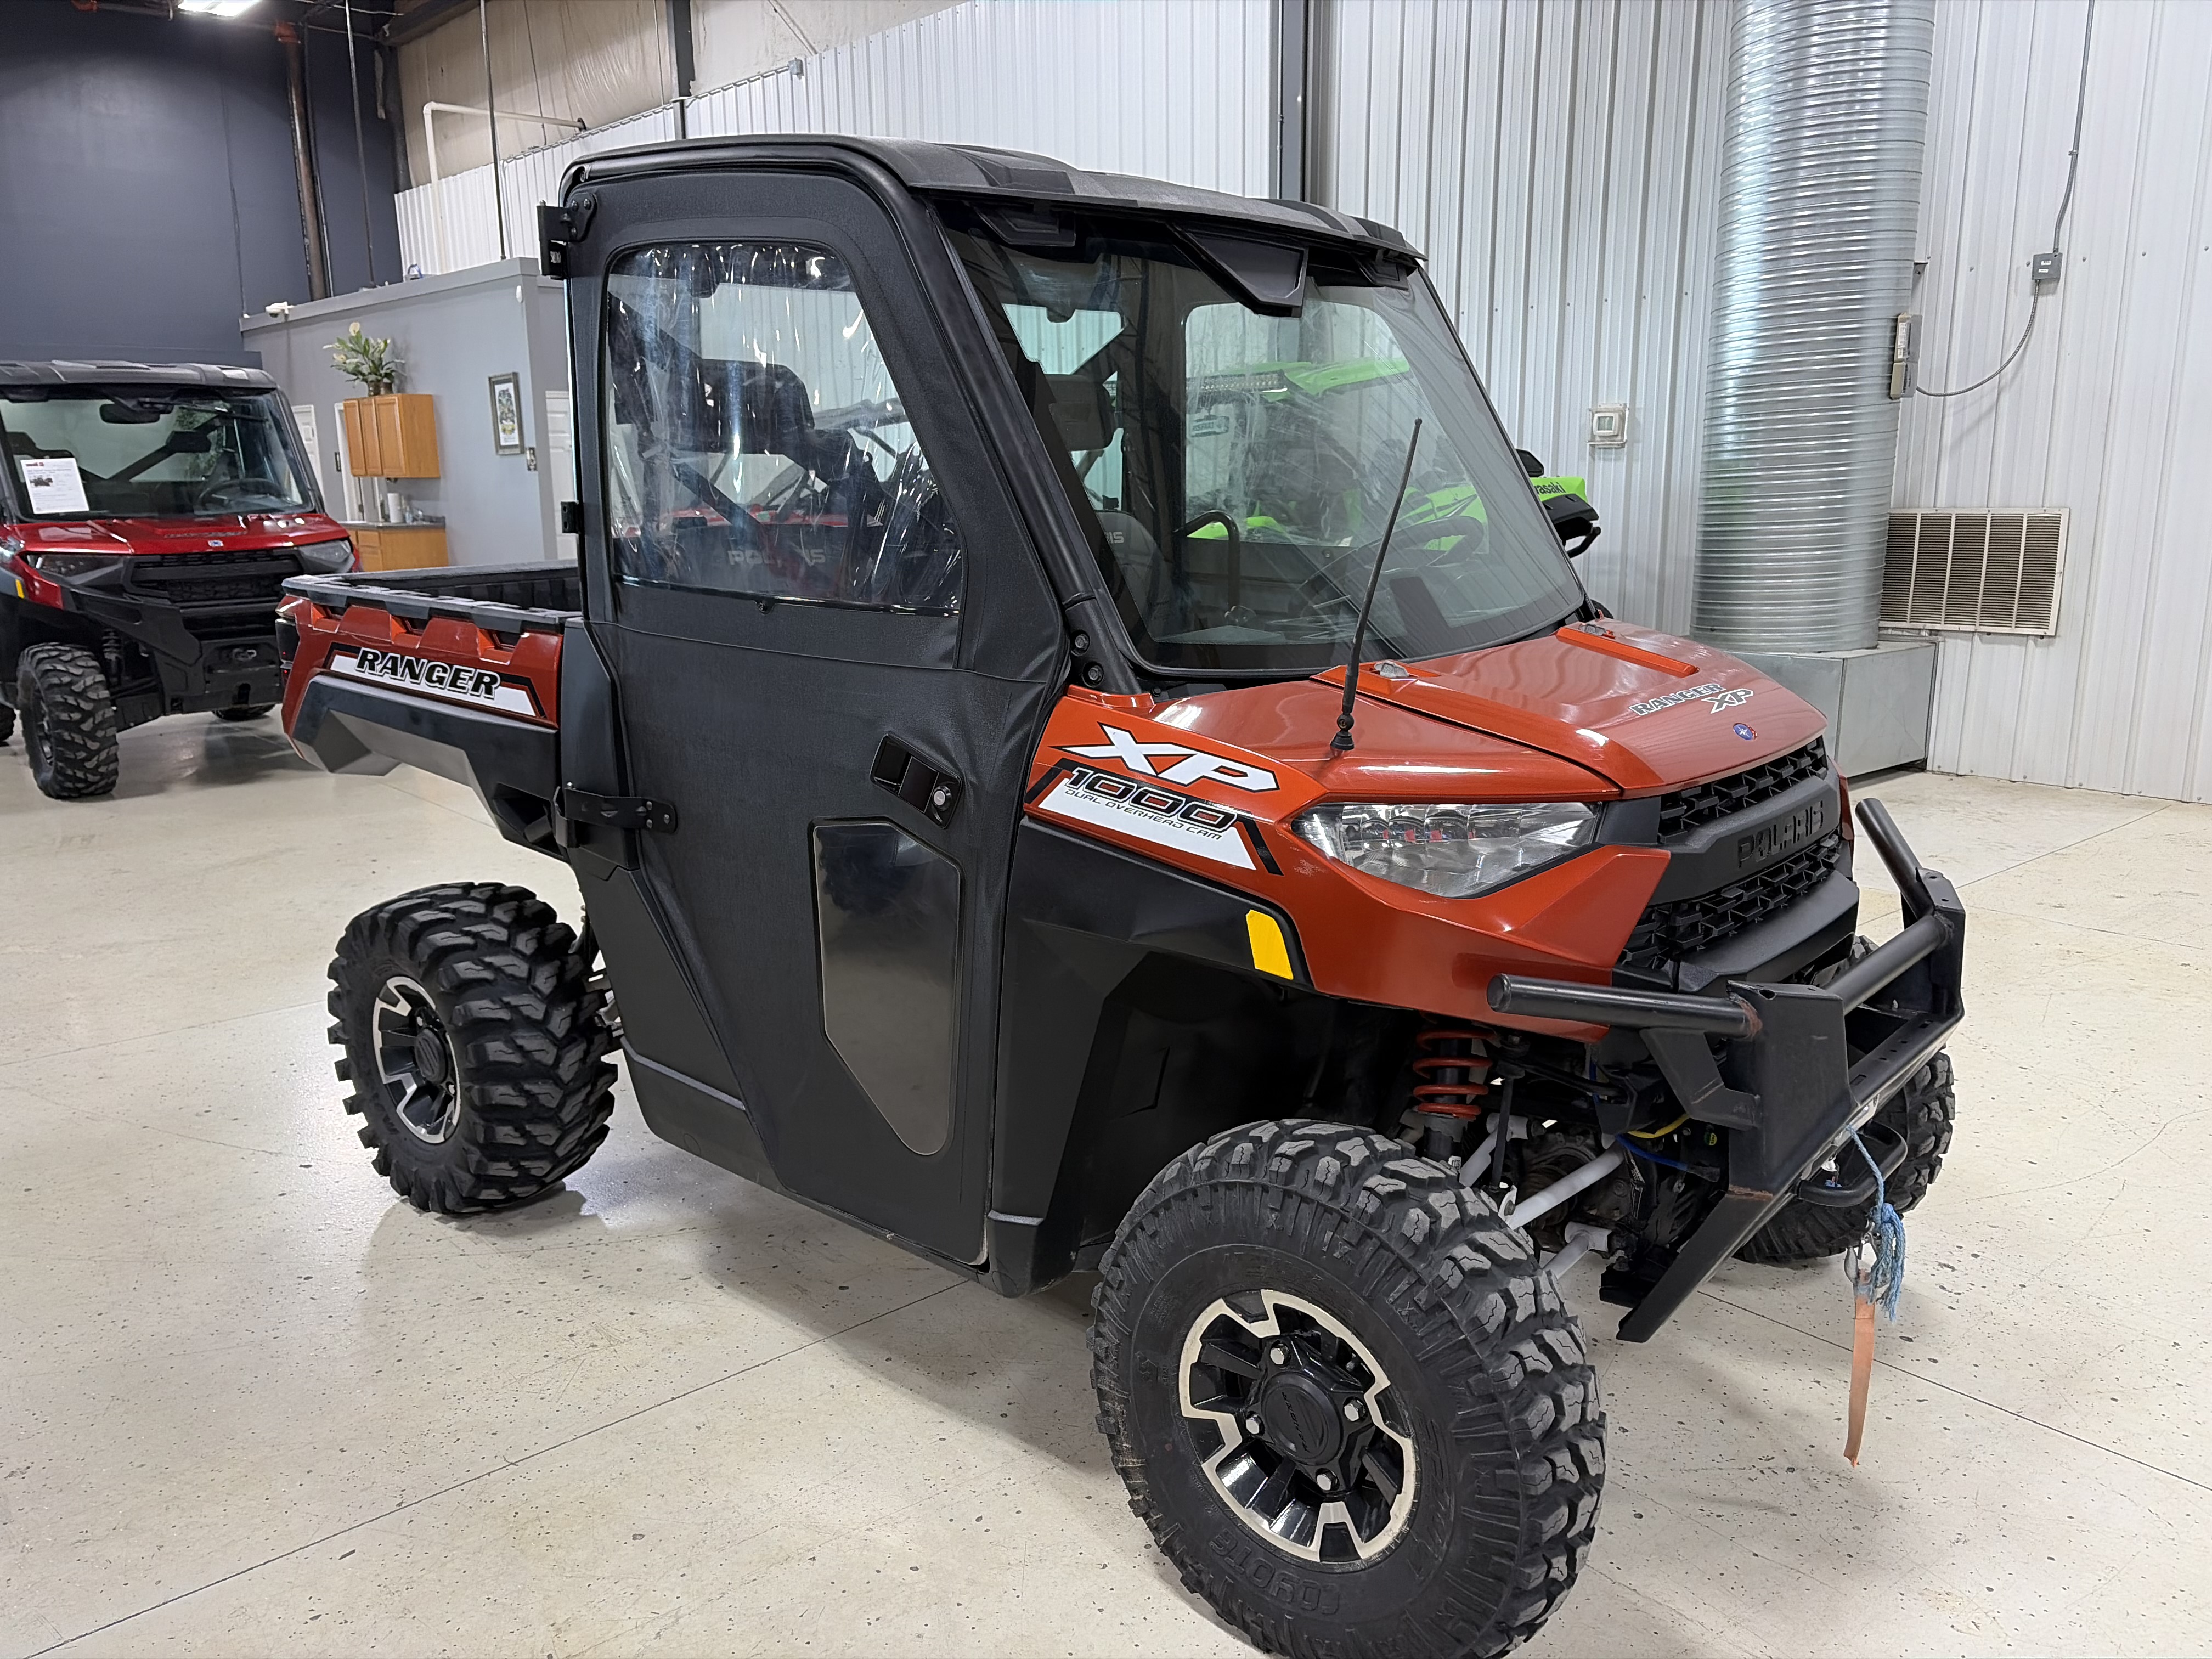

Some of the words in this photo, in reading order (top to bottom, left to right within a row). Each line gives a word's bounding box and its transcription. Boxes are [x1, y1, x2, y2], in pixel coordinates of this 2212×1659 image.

[355, 647, 500, 701] RANGER
[1629, 682, 1726, 715] RANGER
[1701, 688, 1754, 714] XP
[1048, 721, 1280, 793] XP
[1065, 766, 1238, 833] 1000
[1065, 789, 1101, 805] DUAL
[1105, 802, 1184, 828] OVERHEAD
[1186, 826, 1222, 840] CAM
[1737, 799, 1825, 868] POLARIS
